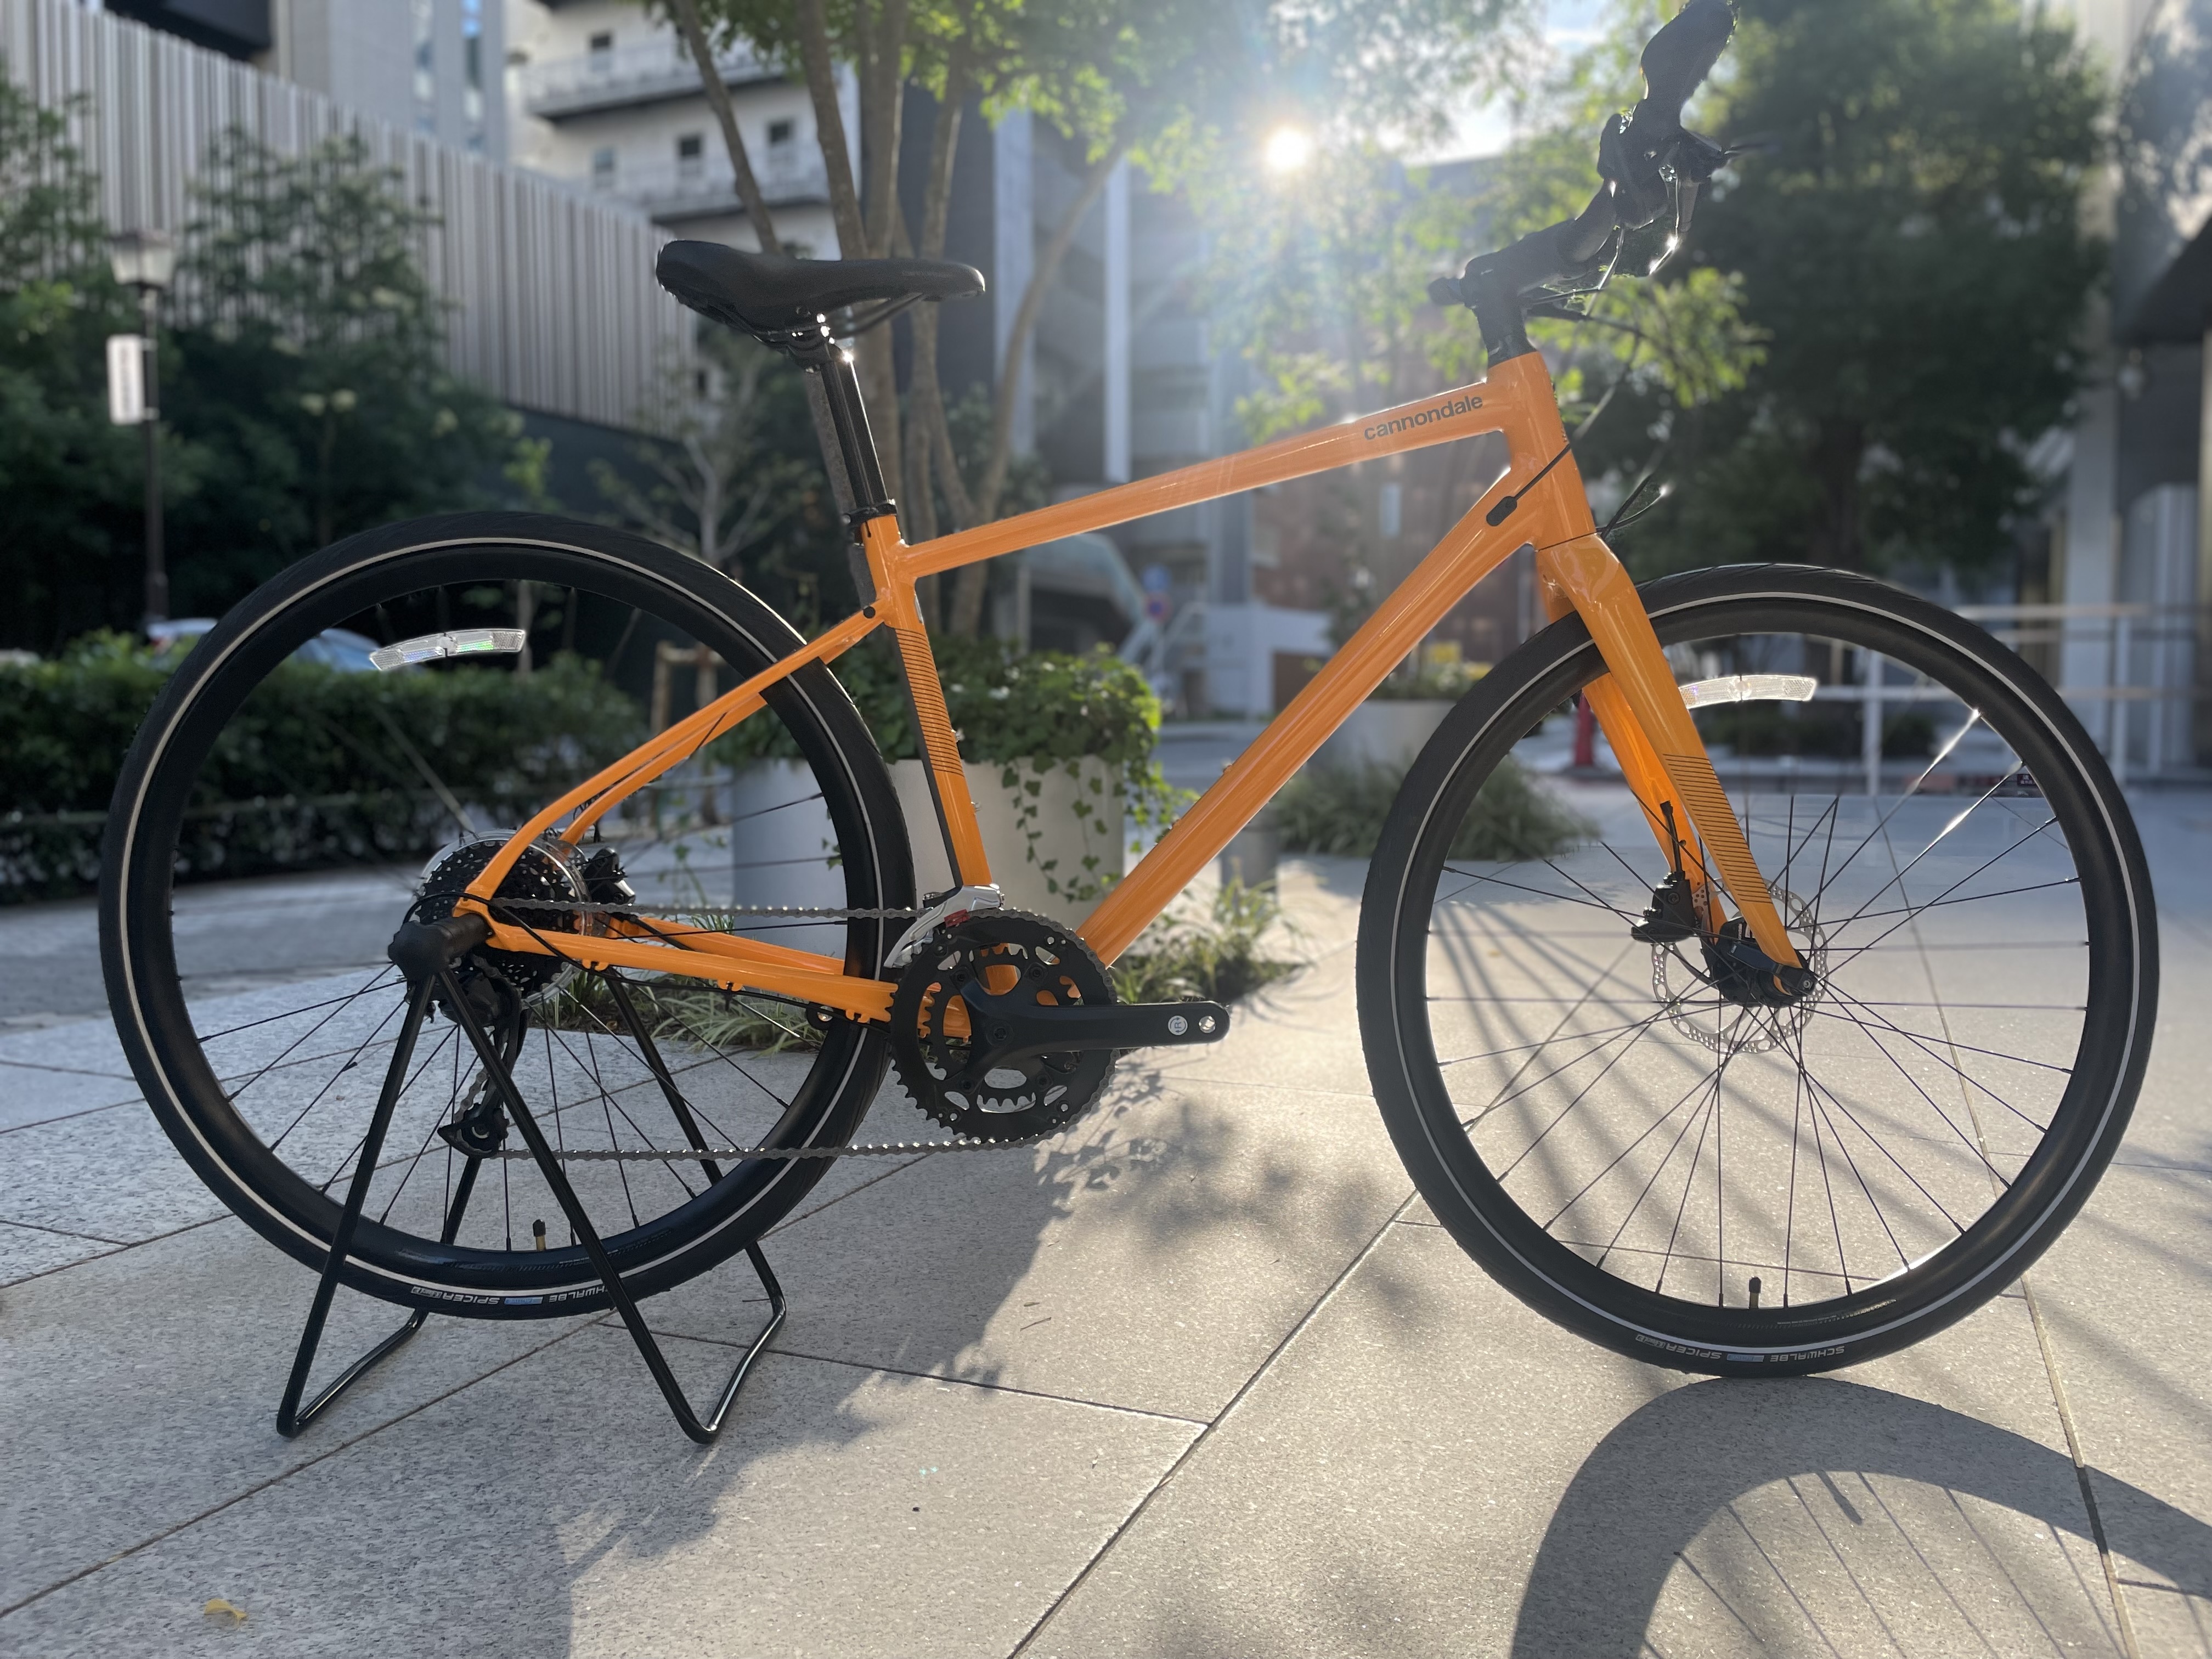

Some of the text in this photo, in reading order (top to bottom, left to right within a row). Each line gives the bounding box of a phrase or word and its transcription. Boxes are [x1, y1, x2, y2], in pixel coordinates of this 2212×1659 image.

[1364, 396, 1483, 440] cannondale
[442, 1292, 500, 1305] SPICER
[549, 1285, 608, 1303] HWALBE
[1666, 1343, 1722, 1359] SPICER
[1770, 1346, 1845, 1362] SCHWALBE
